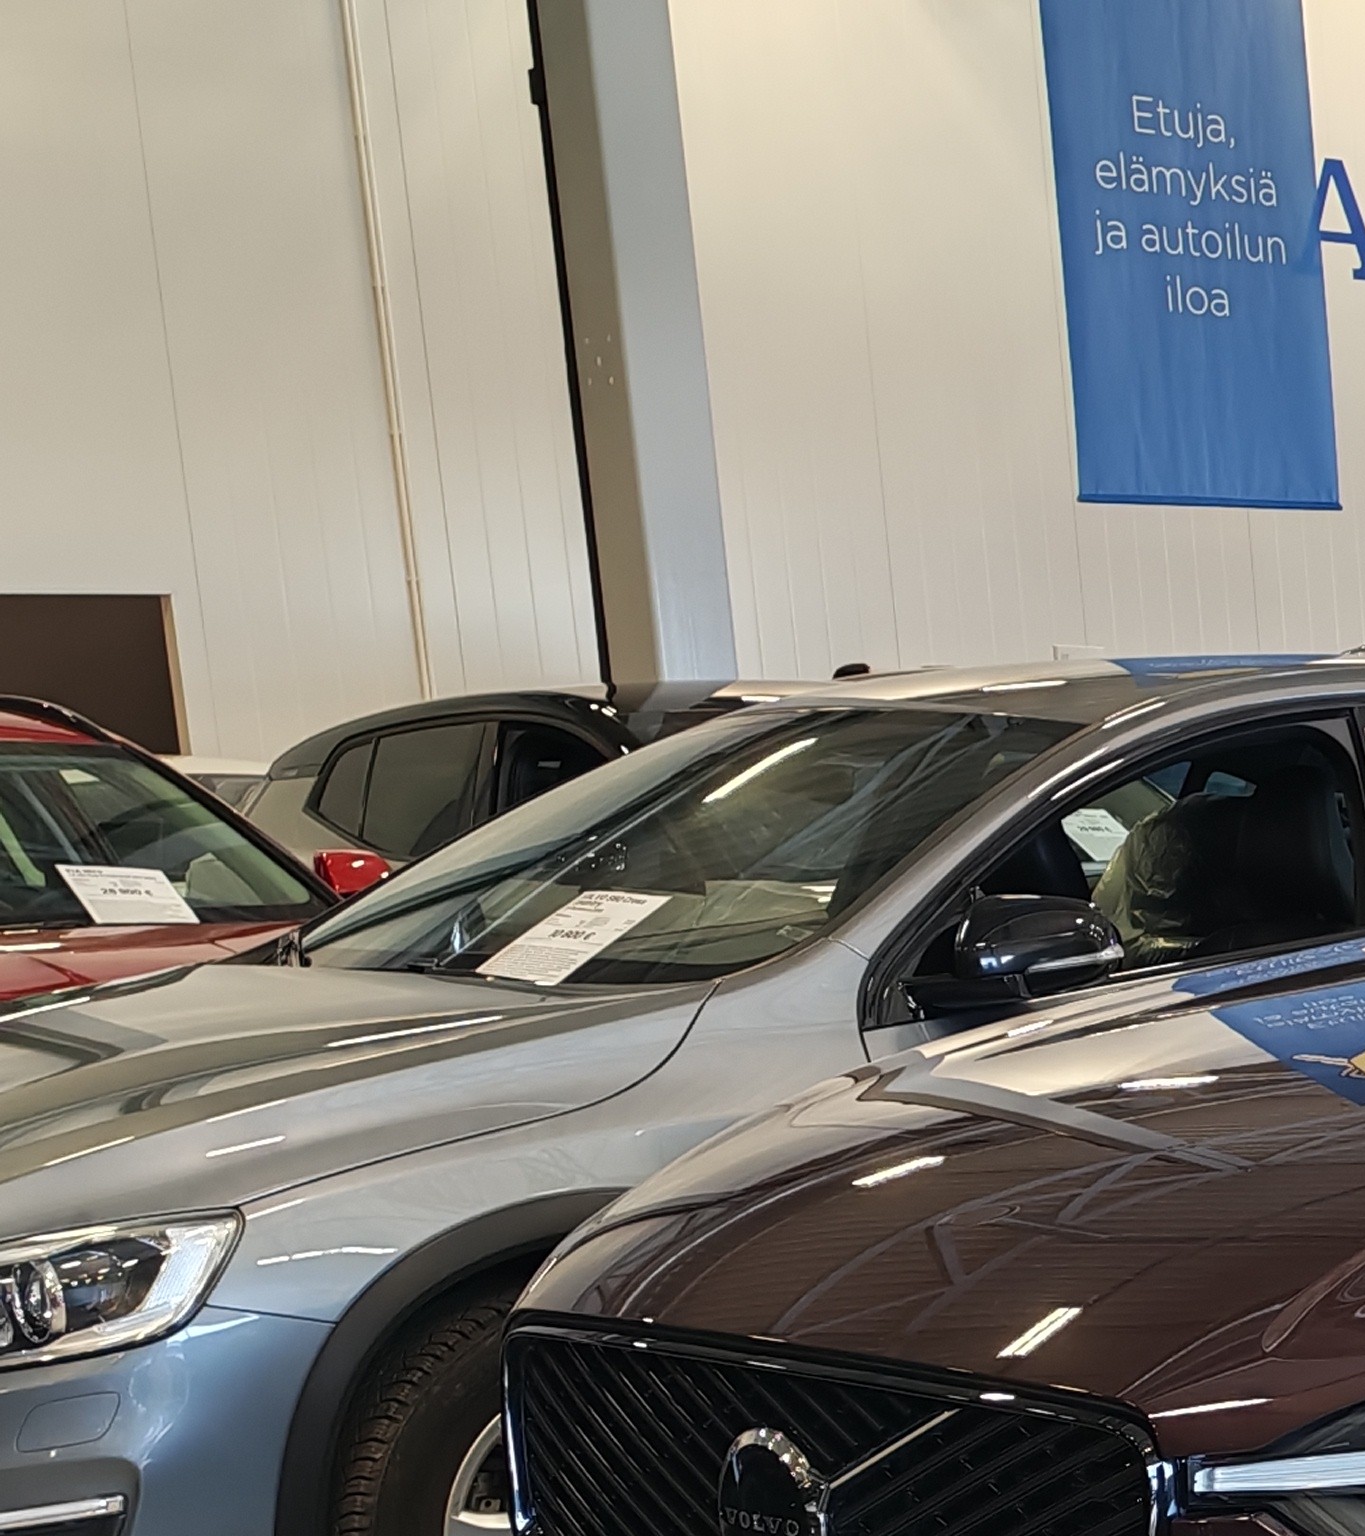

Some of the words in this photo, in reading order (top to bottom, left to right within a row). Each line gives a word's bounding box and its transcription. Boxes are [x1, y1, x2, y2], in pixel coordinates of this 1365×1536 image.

[1131, 94, 1236, 149] Etuja,
[1095, 151, 1277, 207] elämyksiä
[1094, 209, 1128, 255] ja
[1140, 220, 1287, 265] autoilun
[1166, 274, 1230, 317] iloa
